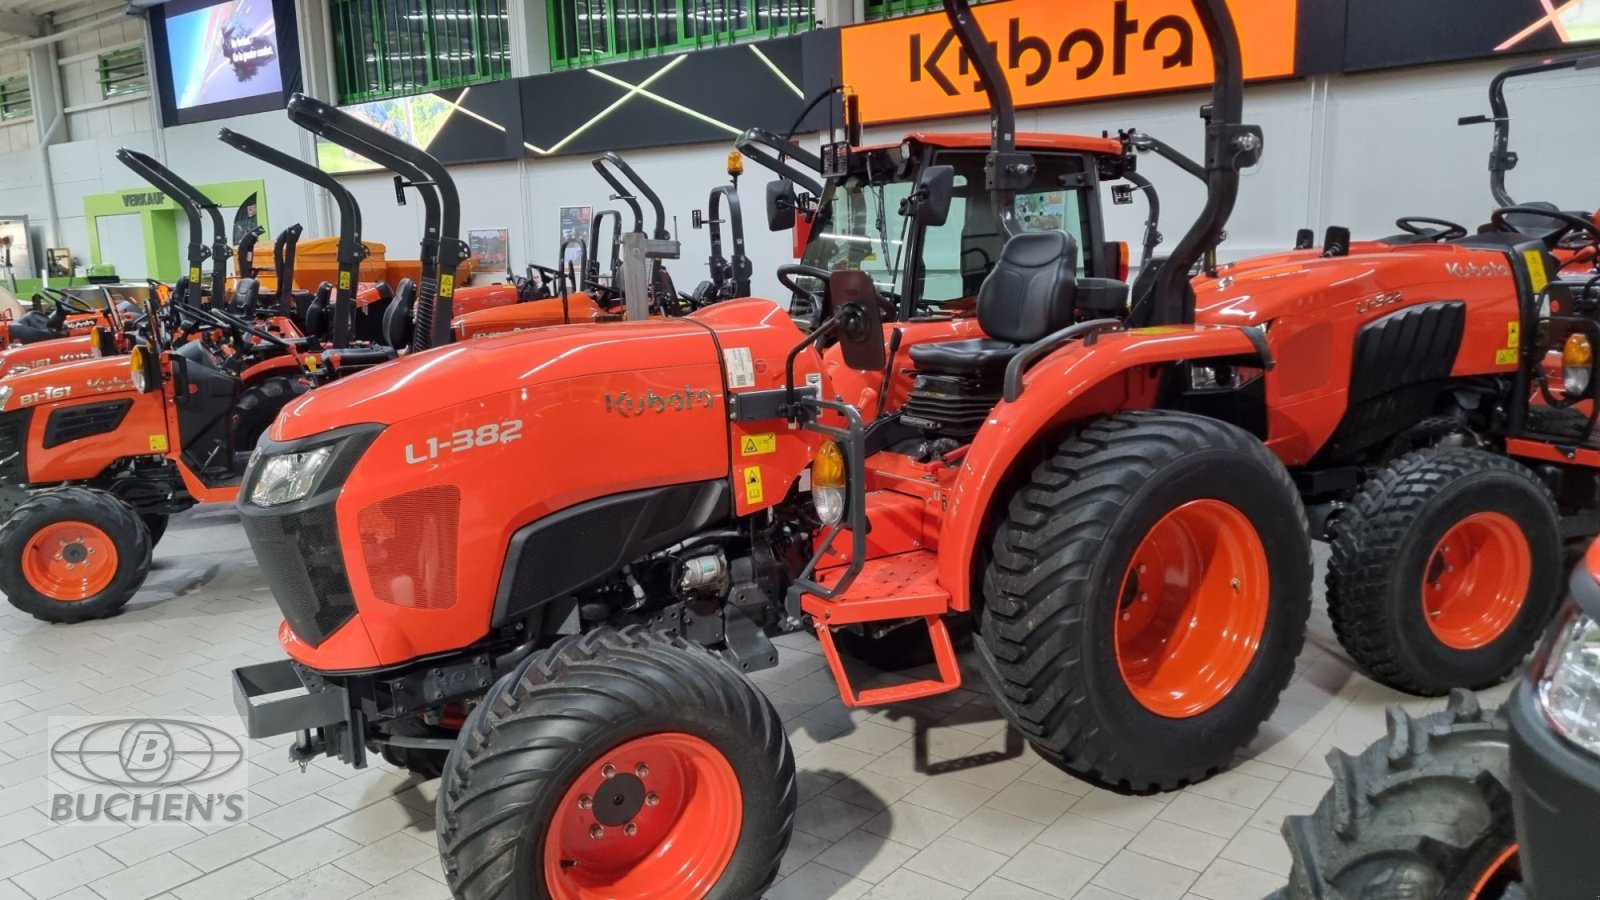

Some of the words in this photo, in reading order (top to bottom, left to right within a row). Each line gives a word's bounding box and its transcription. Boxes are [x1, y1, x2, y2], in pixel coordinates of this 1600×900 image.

[122, 192, 165, 207] VERKAUF
[1445, 261, 1510, 278] Kubota
[20, 386, 72, 405] B1-161
[604, 384, 714, 418] Kubota
[405, 419, 524, 465] L1-382
